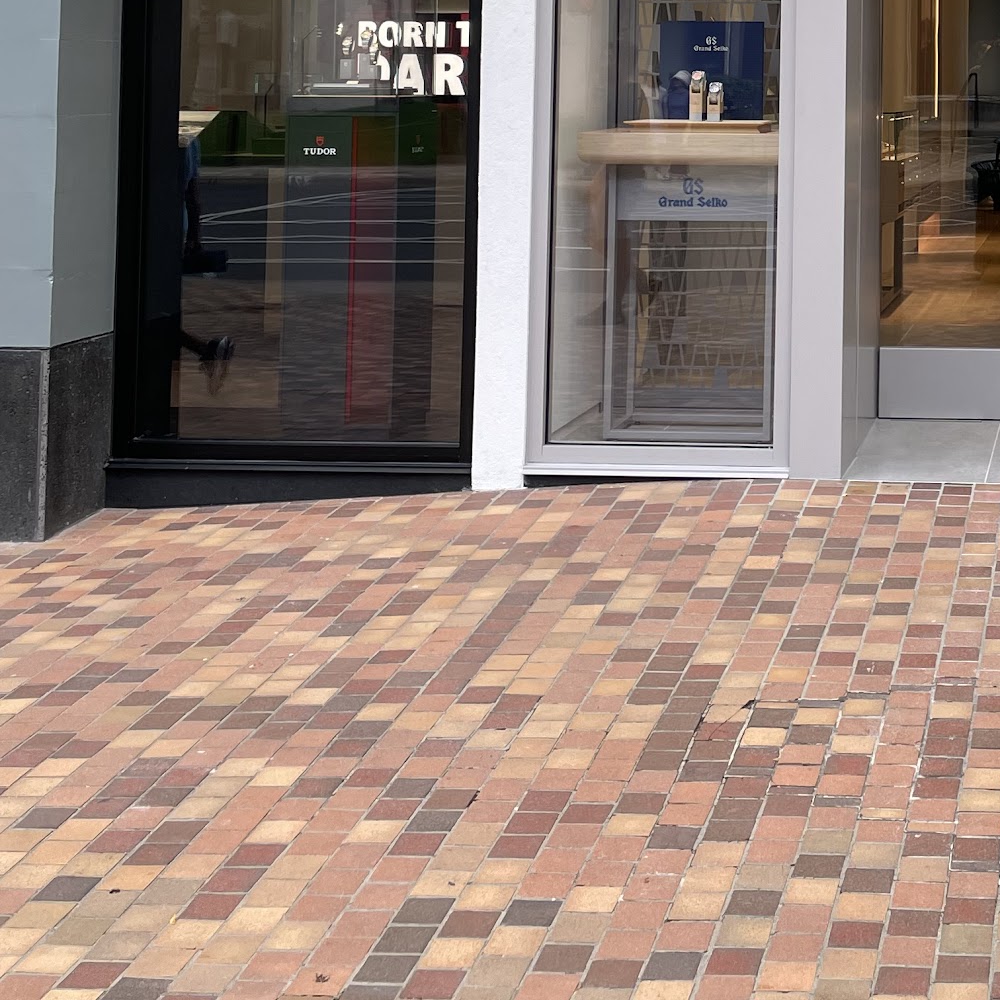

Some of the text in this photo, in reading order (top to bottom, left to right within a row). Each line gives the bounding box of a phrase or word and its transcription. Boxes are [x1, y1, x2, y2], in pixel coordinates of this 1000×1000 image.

[303, 147, 337, 156] TUDOR
[658, 196, 728, 208] Grand Seiko
